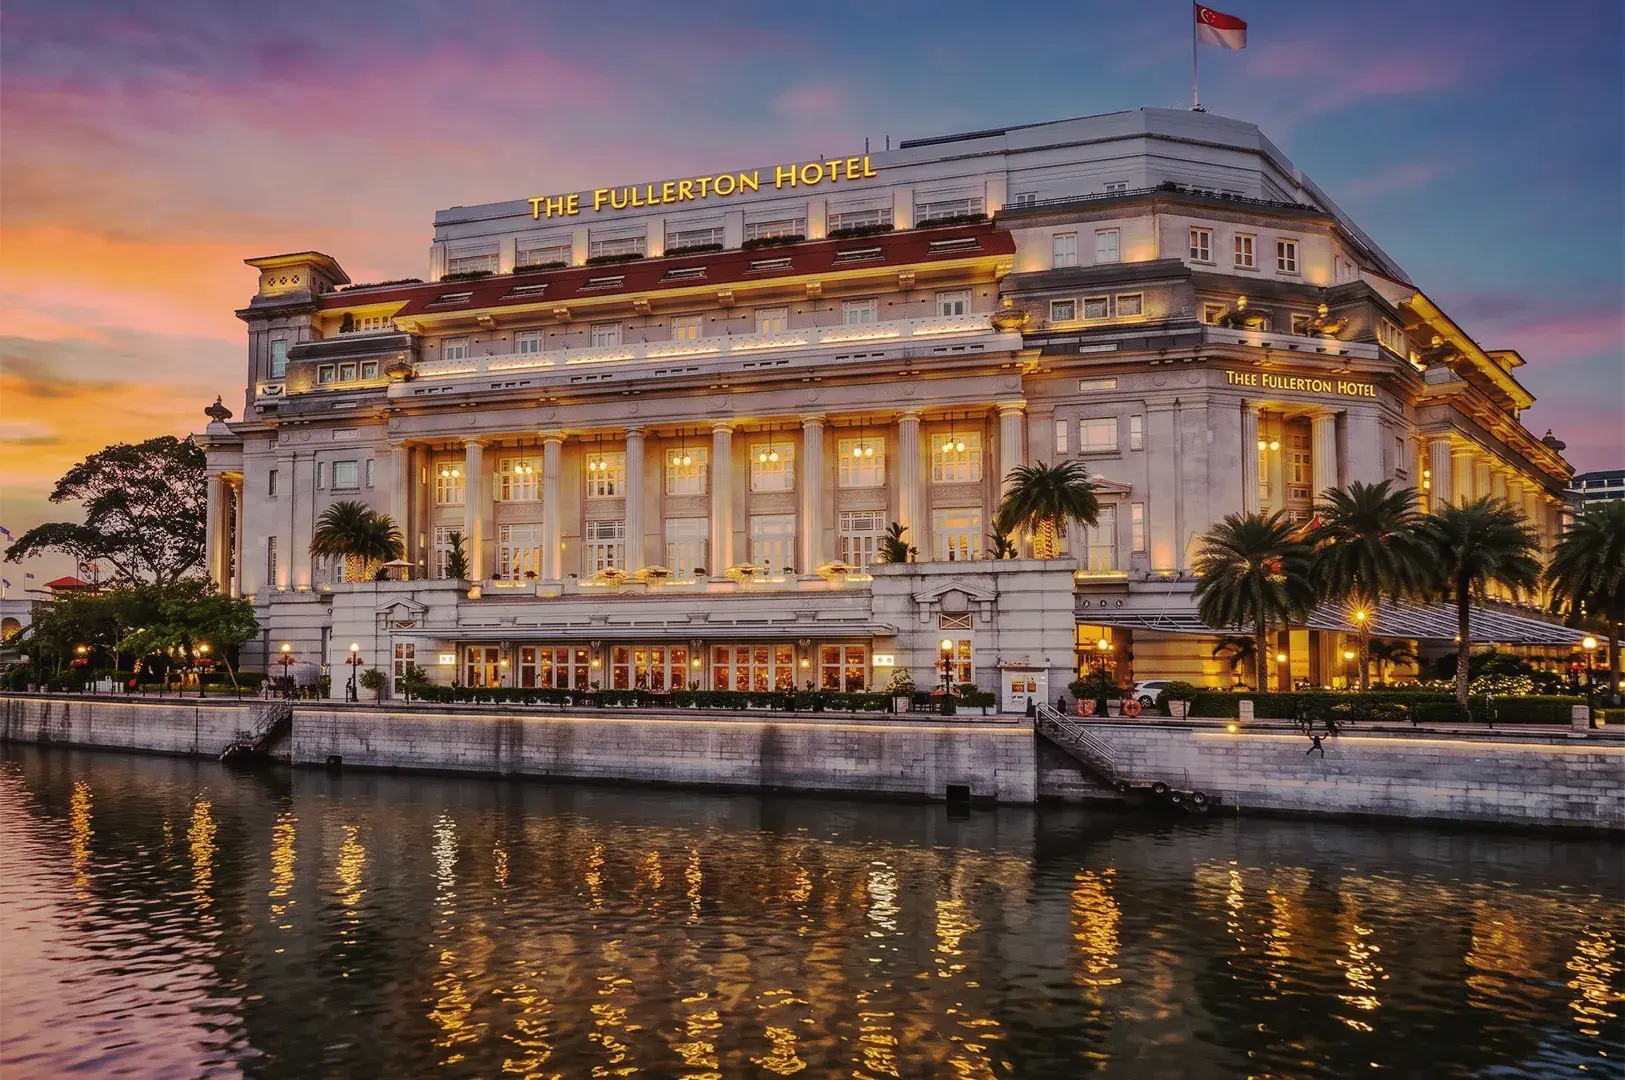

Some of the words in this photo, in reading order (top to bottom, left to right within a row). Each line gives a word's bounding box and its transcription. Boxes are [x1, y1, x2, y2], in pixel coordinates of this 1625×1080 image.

[528, 194, 579, 219] THE
[593, 170, 760, 212] FULLERTON
[775, 156, 878, 189] HOTEL
[1262, 373, 1332, 393] FULLERTON
[1337, 380, 1377, 397] HOTEL
